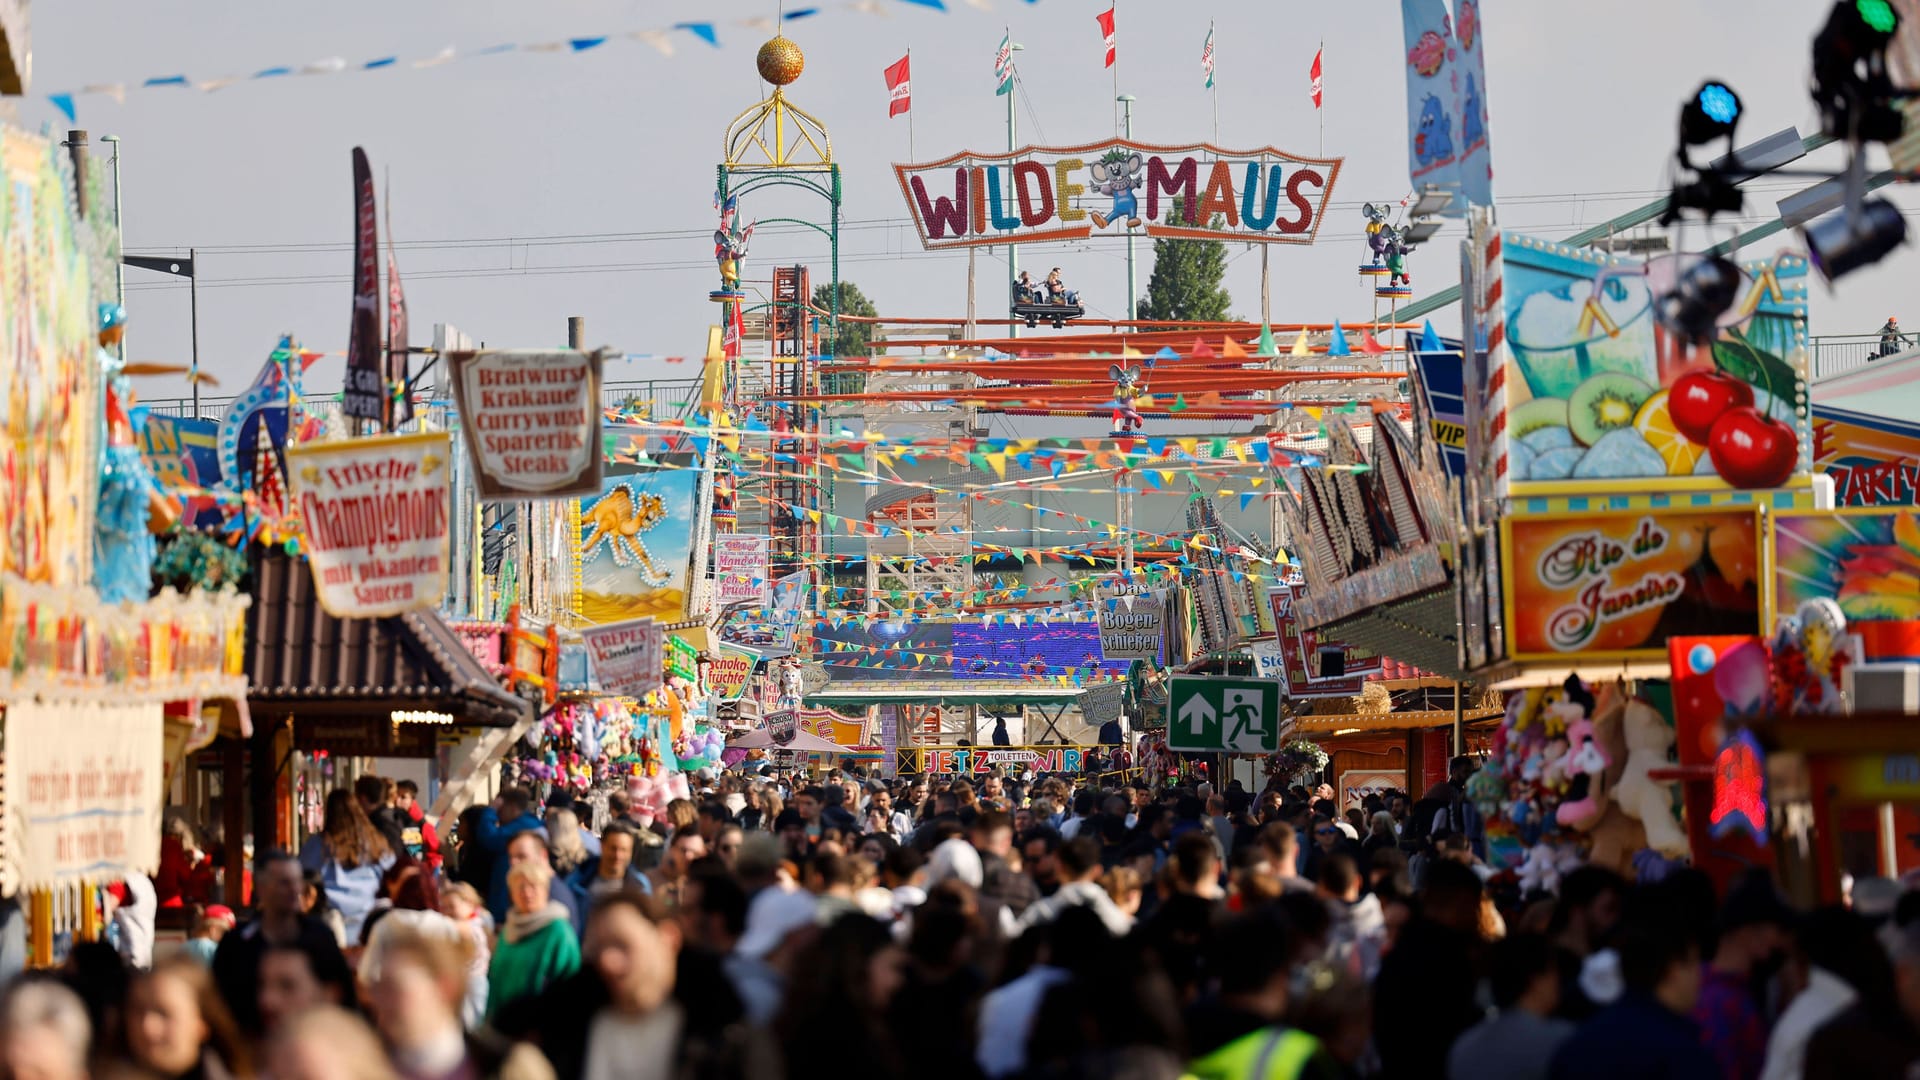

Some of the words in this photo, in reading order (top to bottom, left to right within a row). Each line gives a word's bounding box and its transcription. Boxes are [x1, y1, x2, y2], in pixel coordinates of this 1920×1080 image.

[910, 158, 1085, 239] WILDE
[1146, 155, 1324, 234] MAUS
[477, 365, 586, 387] Bratwurst
[1436, 423, 1465, 444] VIP
[327, 458, 417, 489] Frische
[503, 453, 569, 474] Steaks
[302, 484, 447, 555] Champignons
[1539, 533, 1624, 589] Rio
[1633, 520, 1666, 557] de
[324, 563, 353, 585] mit
[358, 555, 440, 583] pikanten
[353, 583, 413, 606] Saucen
[1113, 580, 1149, 597] Das
[1103, 611, 1160, 632] Bogen-
[1550, 576, 1681, 650] Janeiro
[1102, 632, 1160, 653] schießen
[708, 670, 746, 685] früchte
[990, 751, 1032, 762] TOILETTEN
